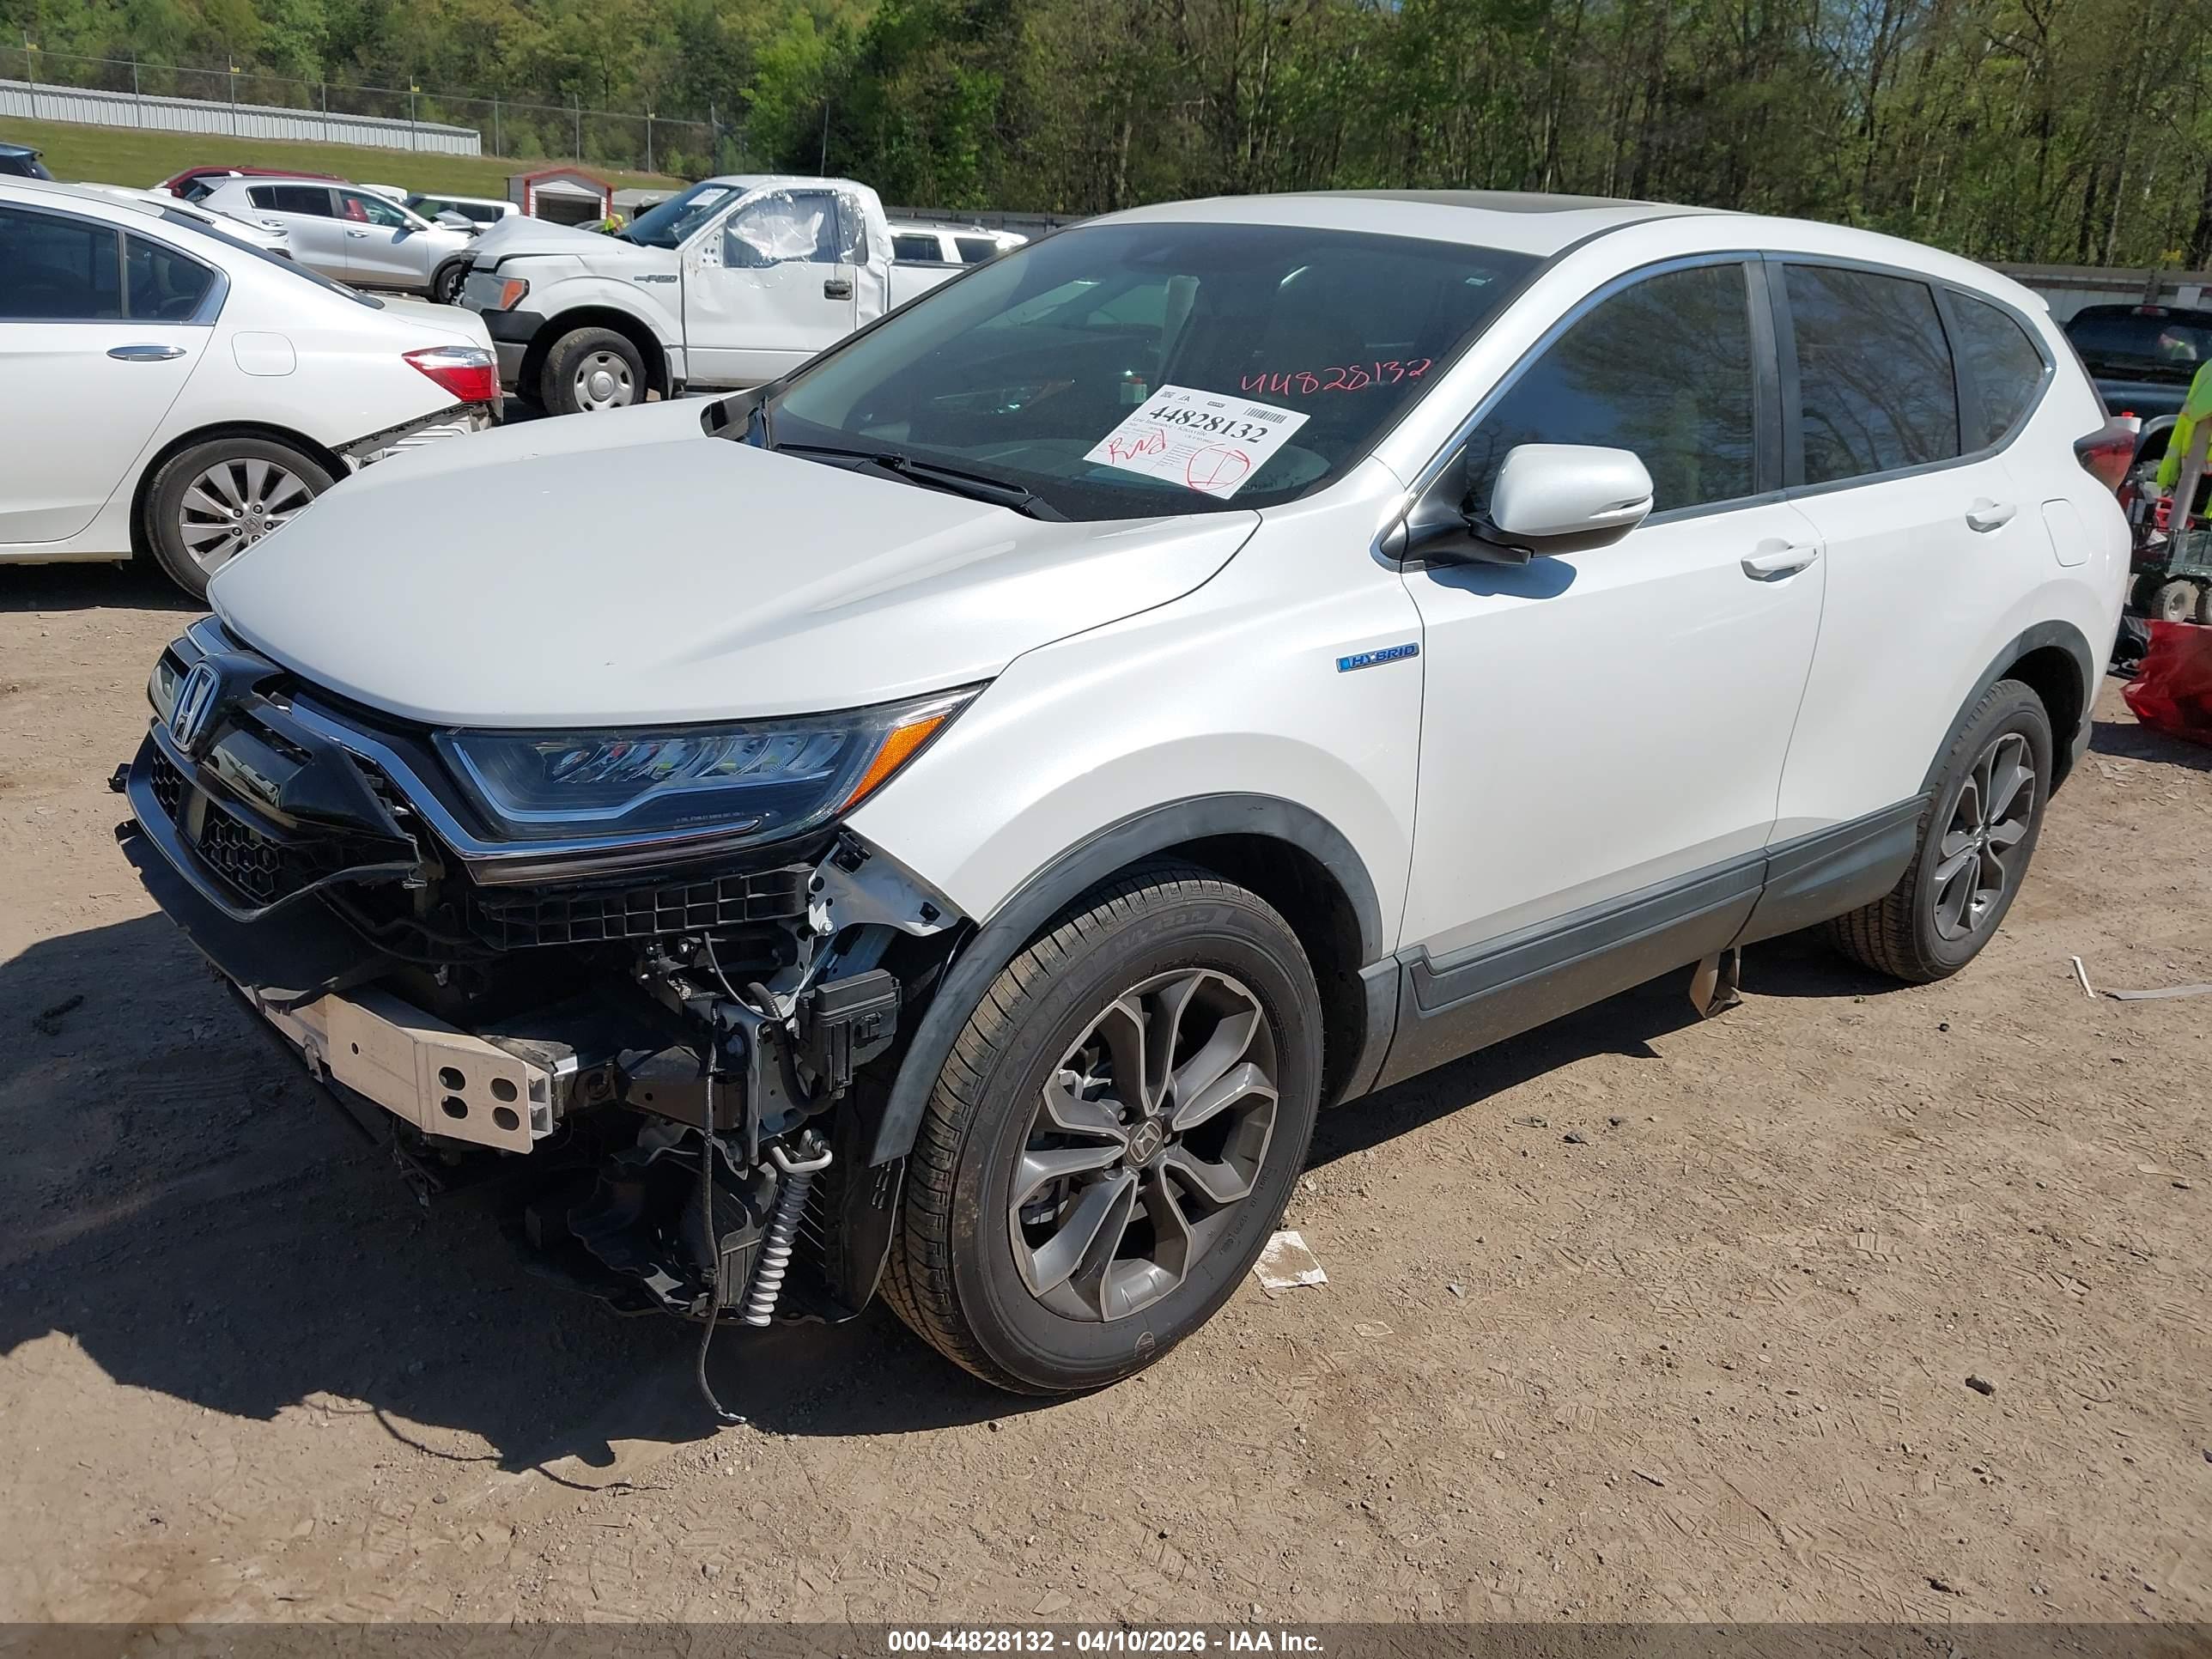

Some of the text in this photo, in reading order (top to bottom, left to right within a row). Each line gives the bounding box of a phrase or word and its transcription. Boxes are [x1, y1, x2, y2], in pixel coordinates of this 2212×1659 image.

[1242, 358, 1432, 397] 44828132
[1149, 405, 1268, 443] 44828132
[1352, 645, 1415, 667] HYBRID
